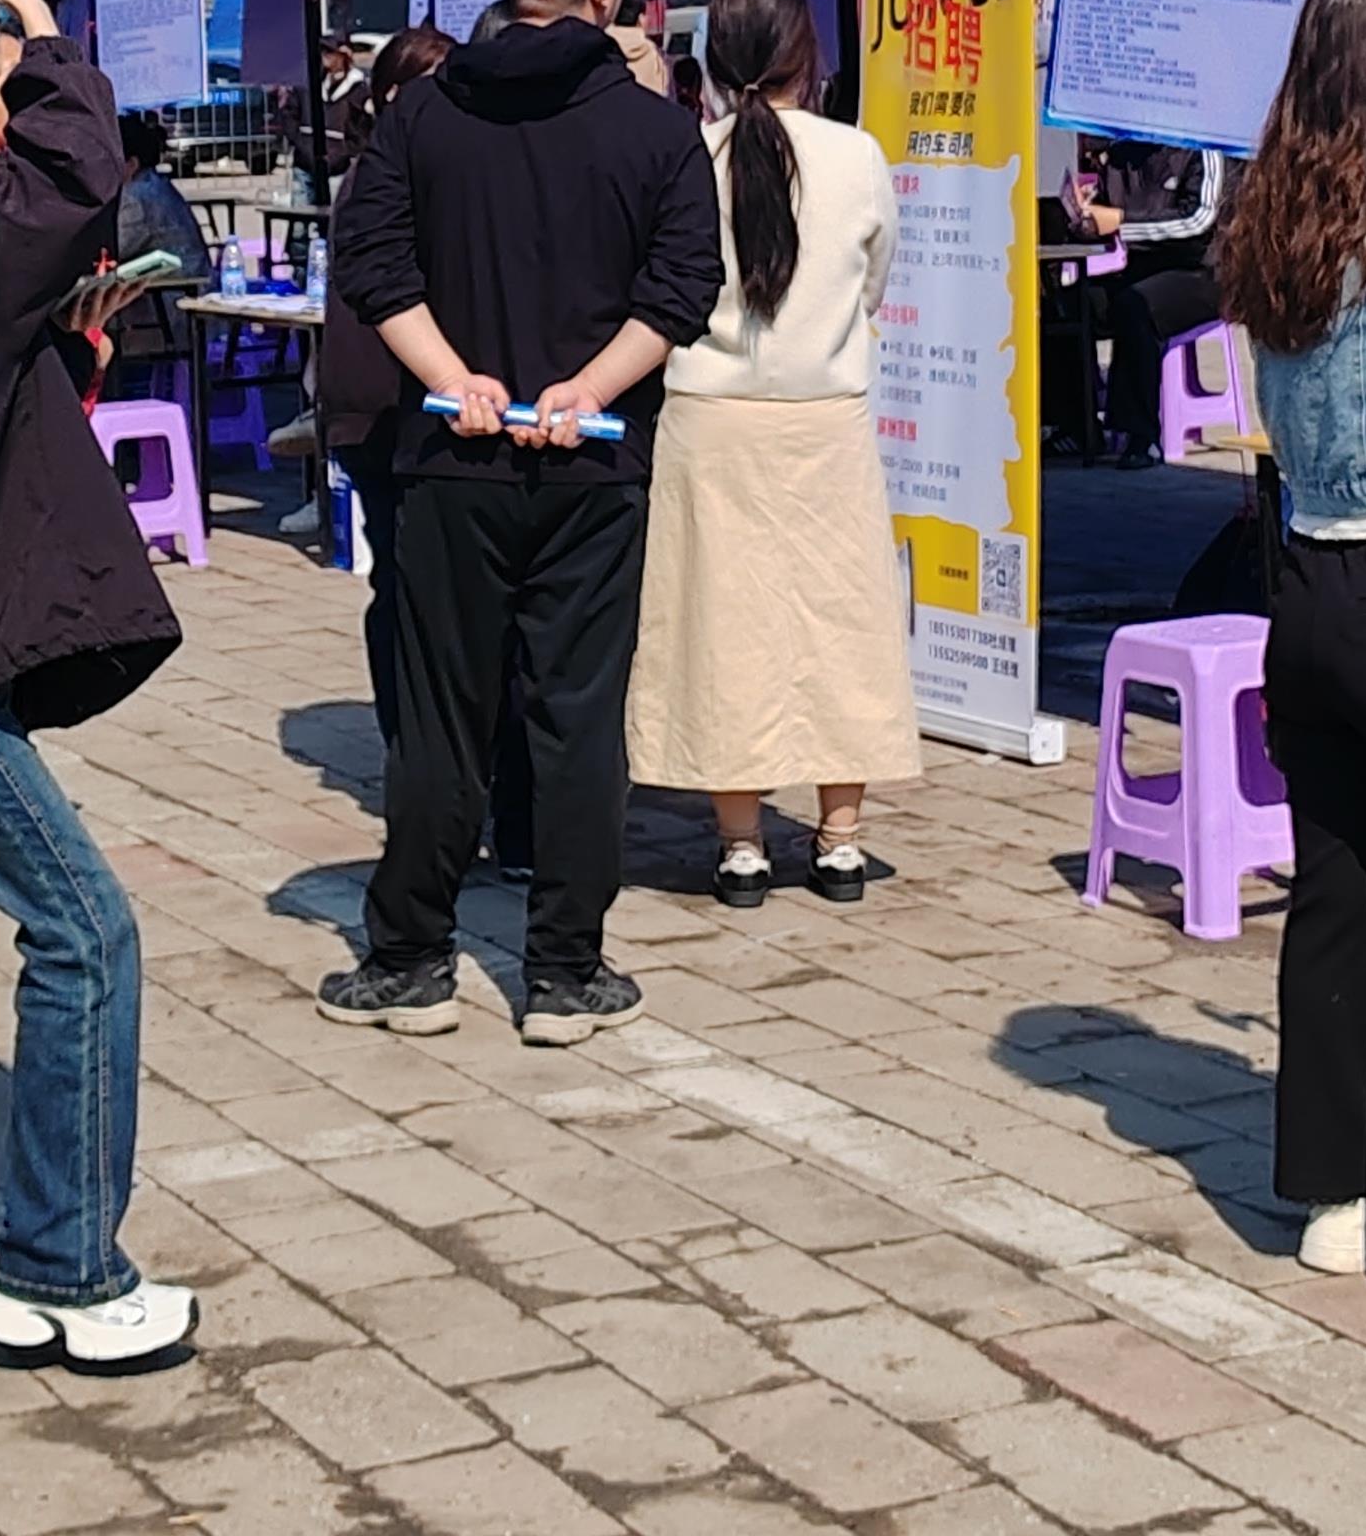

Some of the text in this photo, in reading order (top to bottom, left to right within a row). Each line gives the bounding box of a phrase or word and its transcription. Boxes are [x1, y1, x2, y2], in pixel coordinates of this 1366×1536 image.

[909, 90, 976, 117] 我们需要你
